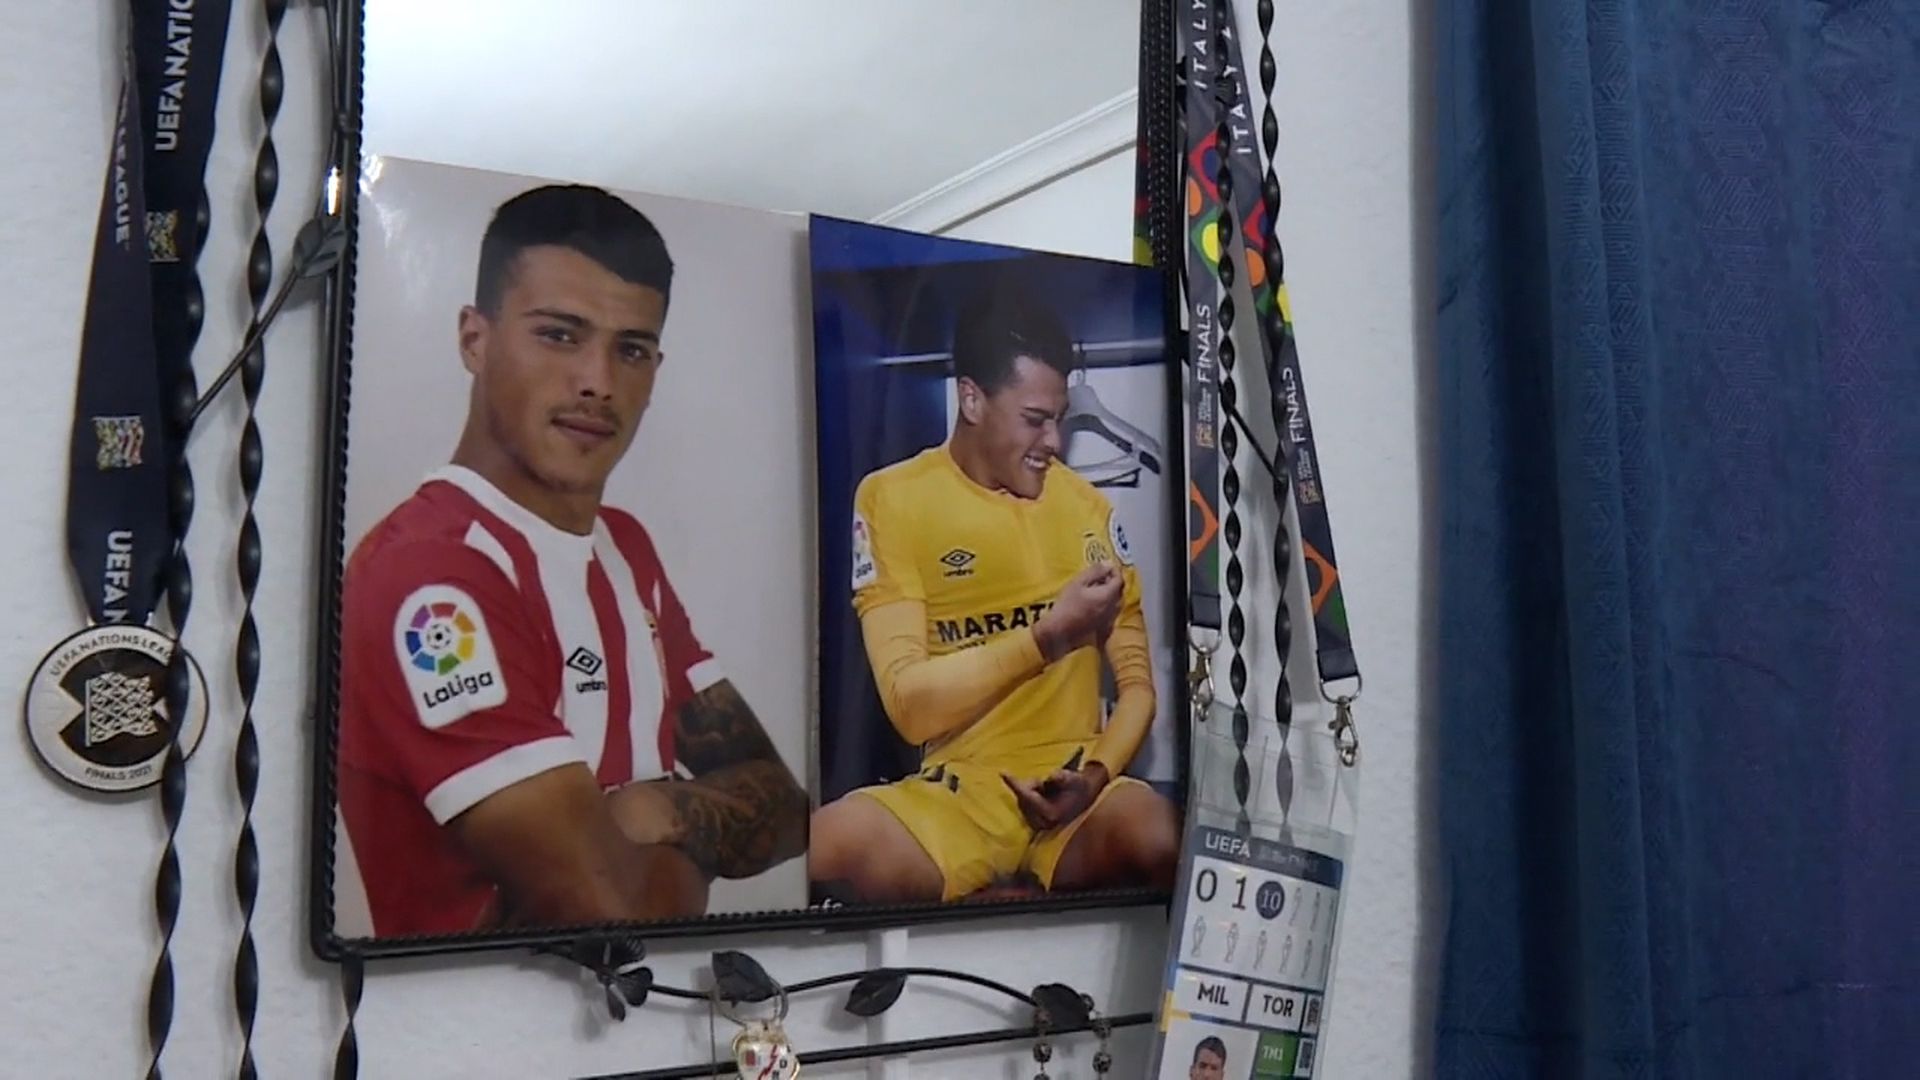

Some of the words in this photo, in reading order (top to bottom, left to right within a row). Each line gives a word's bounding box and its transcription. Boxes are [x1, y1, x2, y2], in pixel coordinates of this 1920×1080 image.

[154, 80, 186, 152] UEFA
[1196, 303, 1213, 384] FINALS
[104, 530, 132, 605] UEFA
[935, 600, 1055, 643] MARAT
[423, 670, 494, 709] LaLiga
[1205, 831, 1251, 859] UEFA
[1231, 876, 1248, 910] 1
[1197, 983, 1230, 1006] MIL
[1263, 995, 1295, 1018] TOR
